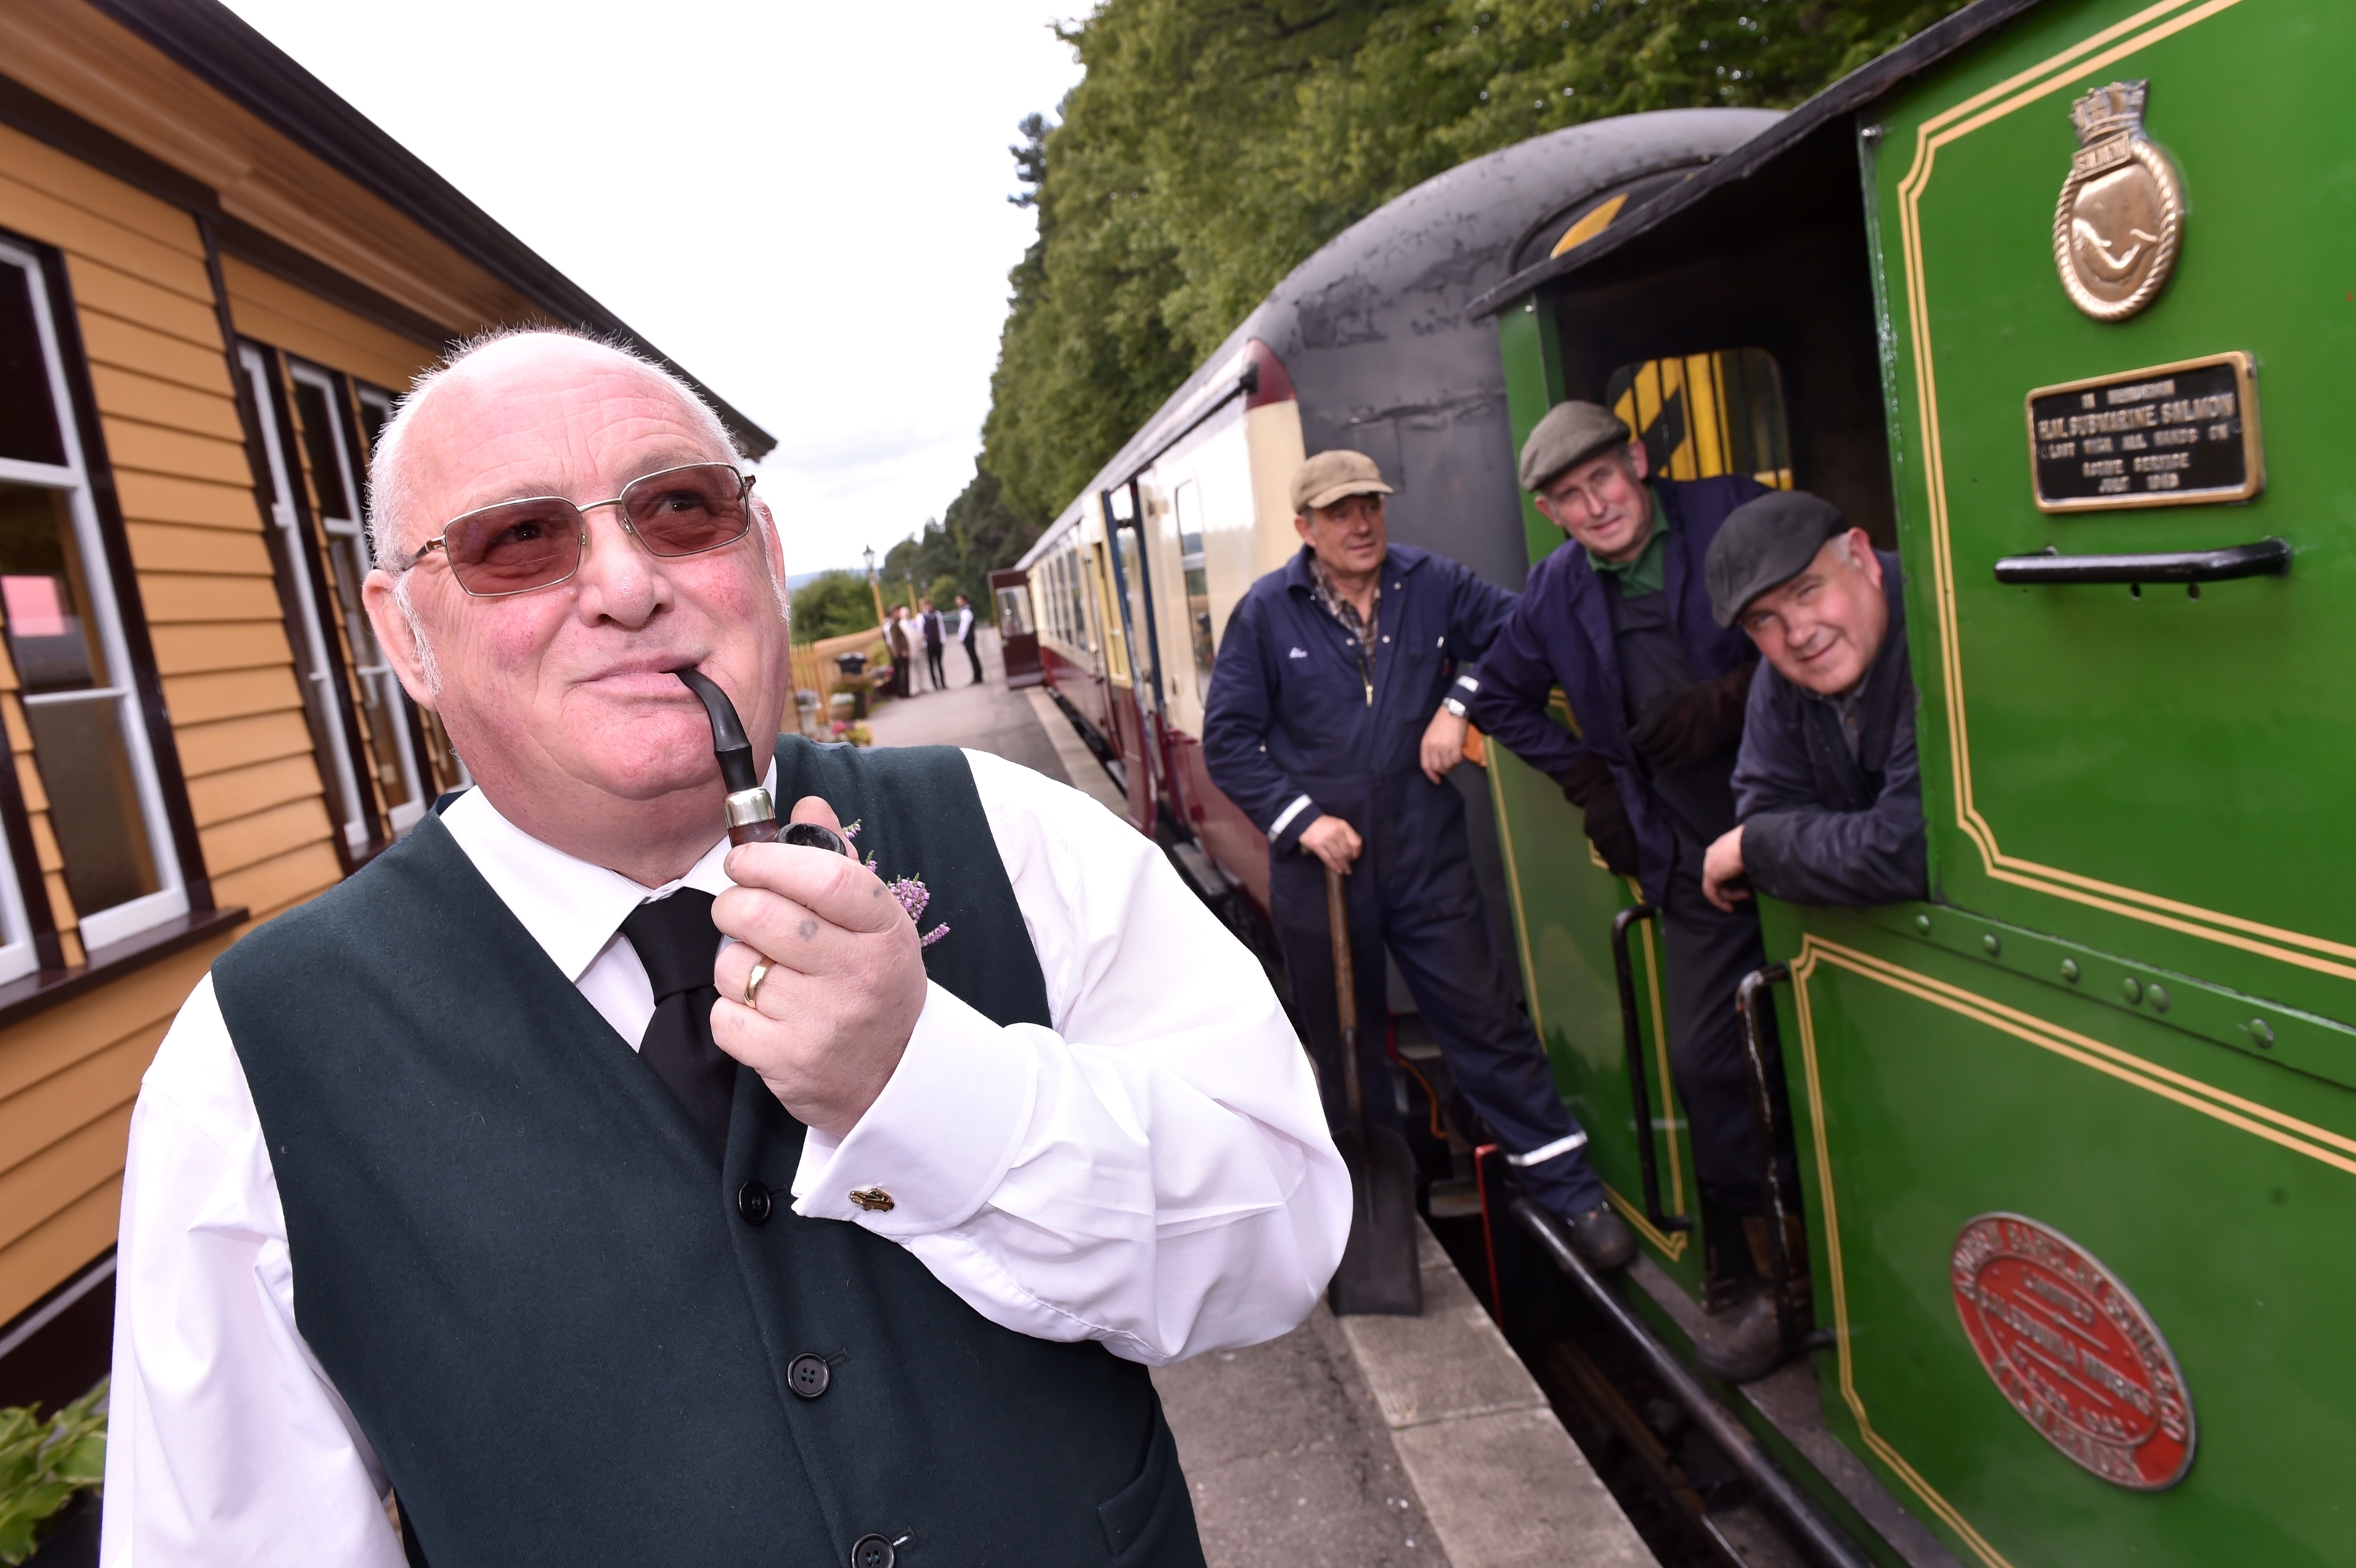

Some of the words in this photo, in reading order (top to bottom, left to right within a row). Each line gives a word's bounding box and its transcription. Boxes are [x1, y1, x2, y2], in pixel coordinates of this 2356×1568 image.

[2160, 392, 2235, 425] SALMON
[2048, 441, 2076, 460] LOST
[2082, 437, 2114, 454] WITH
[2121, 433, 2147, 451] ALL
[2153, 428, 2199, 447] HANDS
[2208, 423, 2229, 441] ON
[2082, 459, 2124, 478] ACTIVE
[2133, 452, 2190, 473] SERVICE
[2098, 475, 2131, 494] JULY
[2006, 1222, 2102, 1299] BARCLAY
